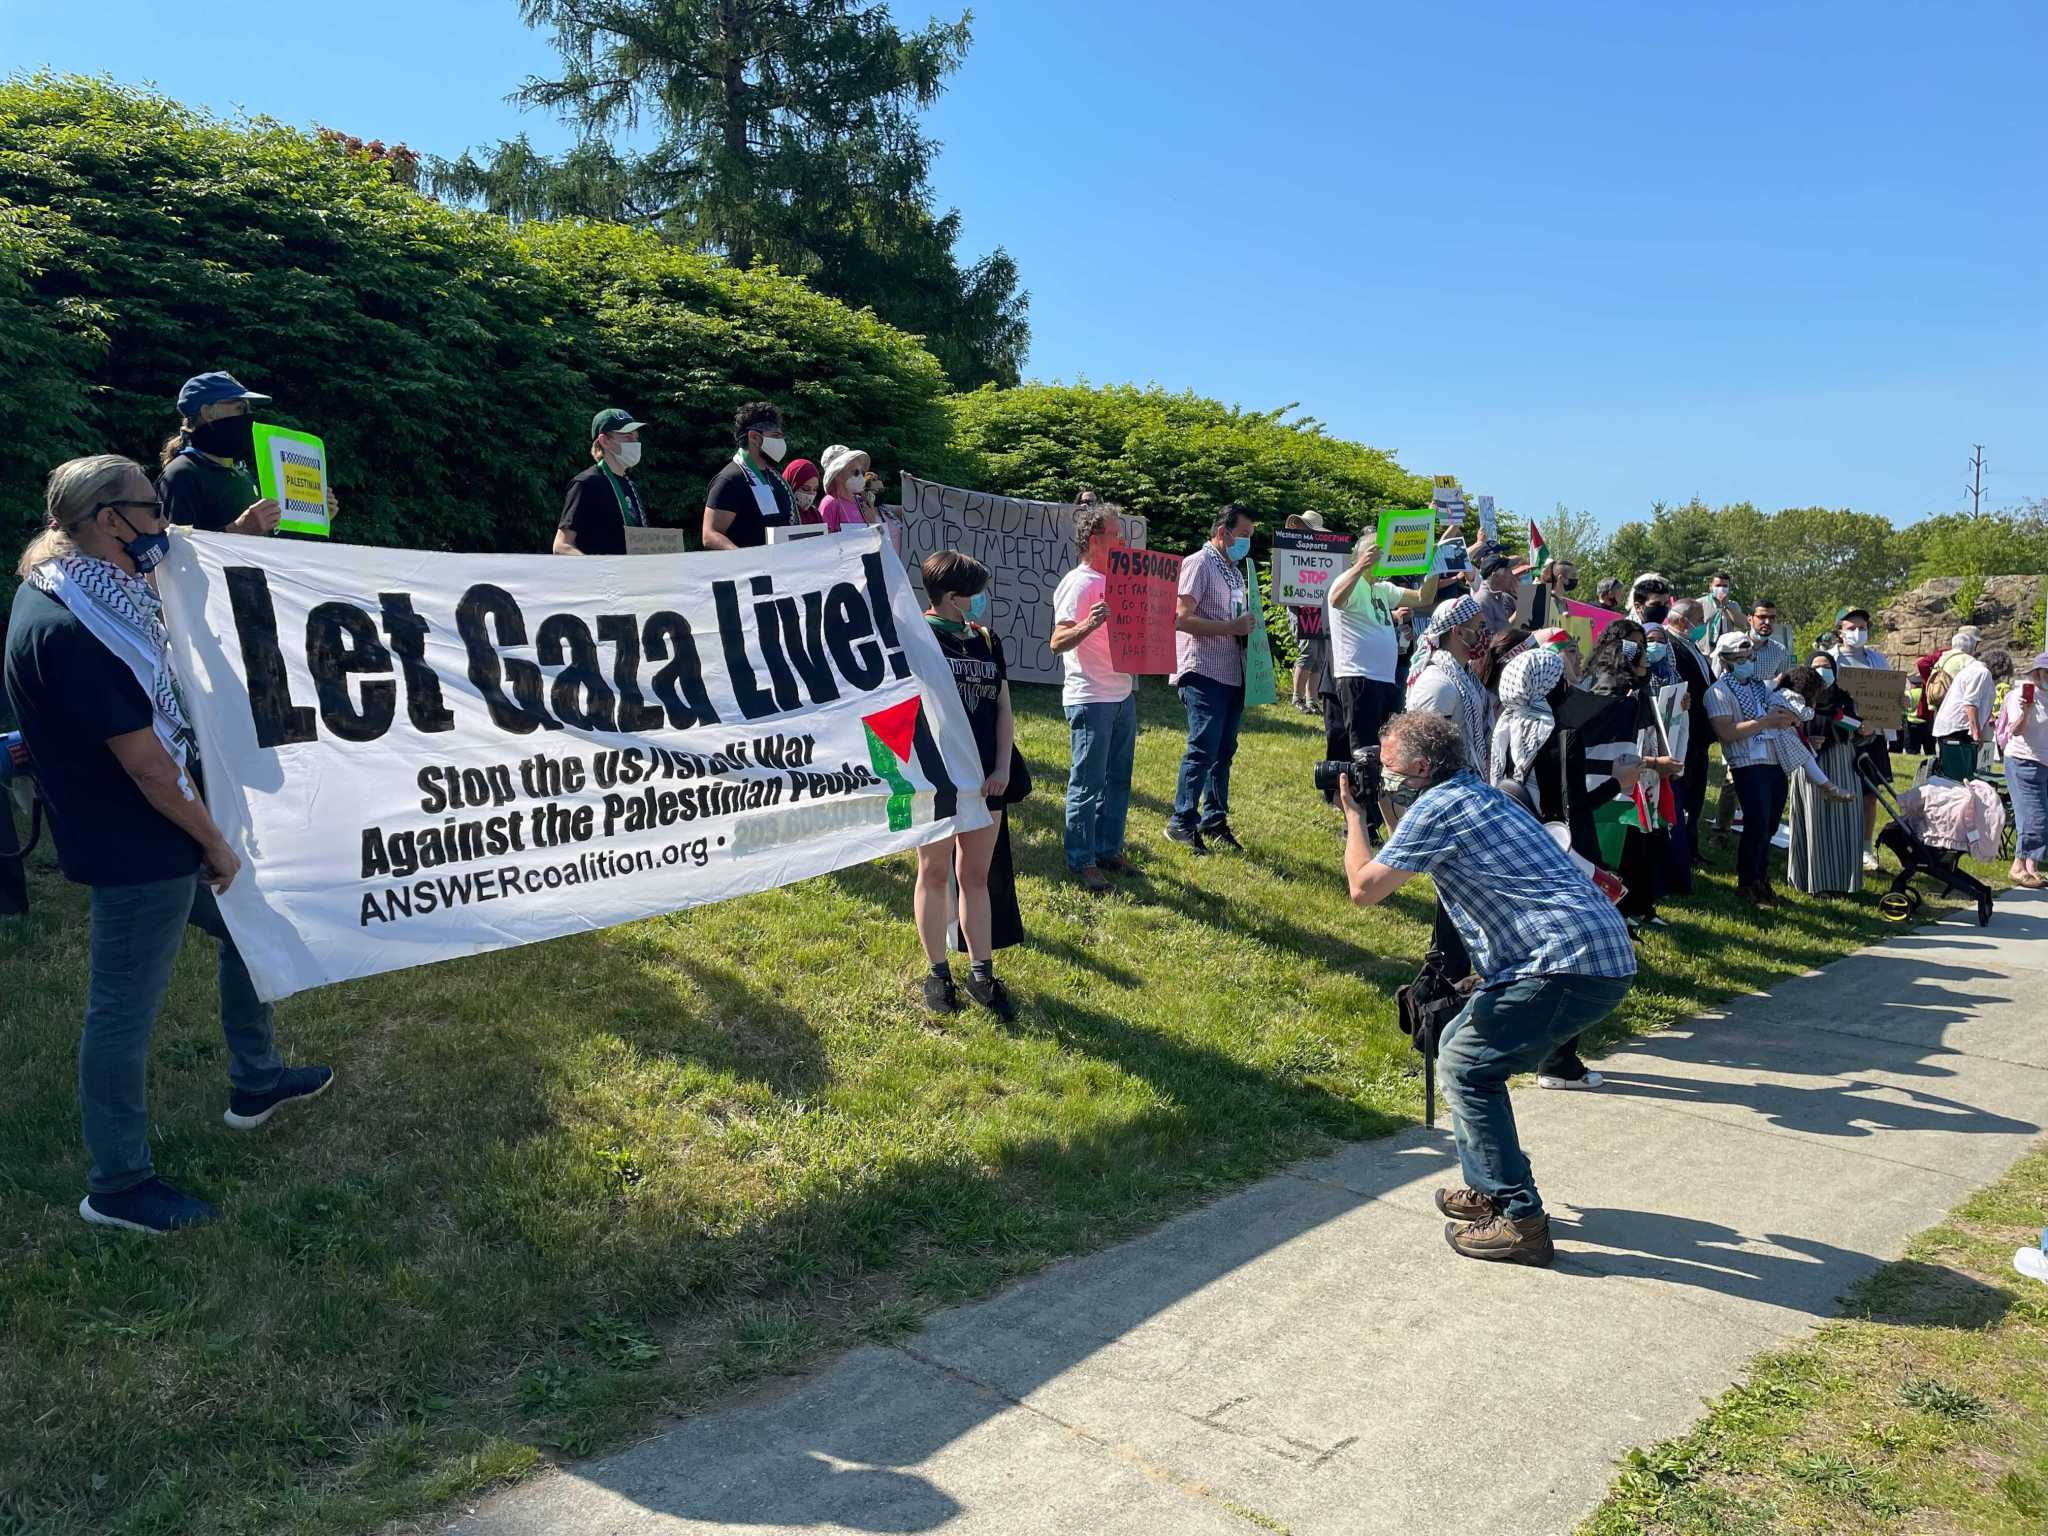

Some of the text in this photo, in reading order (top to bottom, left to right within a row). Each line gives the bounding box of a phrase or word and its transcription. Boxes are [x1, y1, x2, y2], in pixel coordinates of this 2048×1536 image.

[903, 479, 961, 525] JOE
[964, 492, 1061, 540] BIDEN
[902, 516, 1080, 573] YOUR IMPERIA
[1290, 554, 1333, 568] TIME TO
[1296, 540, 1328, 551] Supports
[1294, 588, 1307, 598] AID
[1314, 591, 1325, 599] ISR
[1298, 569, 1328, 585] STOP
[223, 552, 912, 748] Let Gaza Live!
[417, 733, 815, 814] Stop the US/Israeli War
[361, 761, 881, 878] Against the Palestinian People
[361, 836, 708, 926] ANSWERcoalition.org
